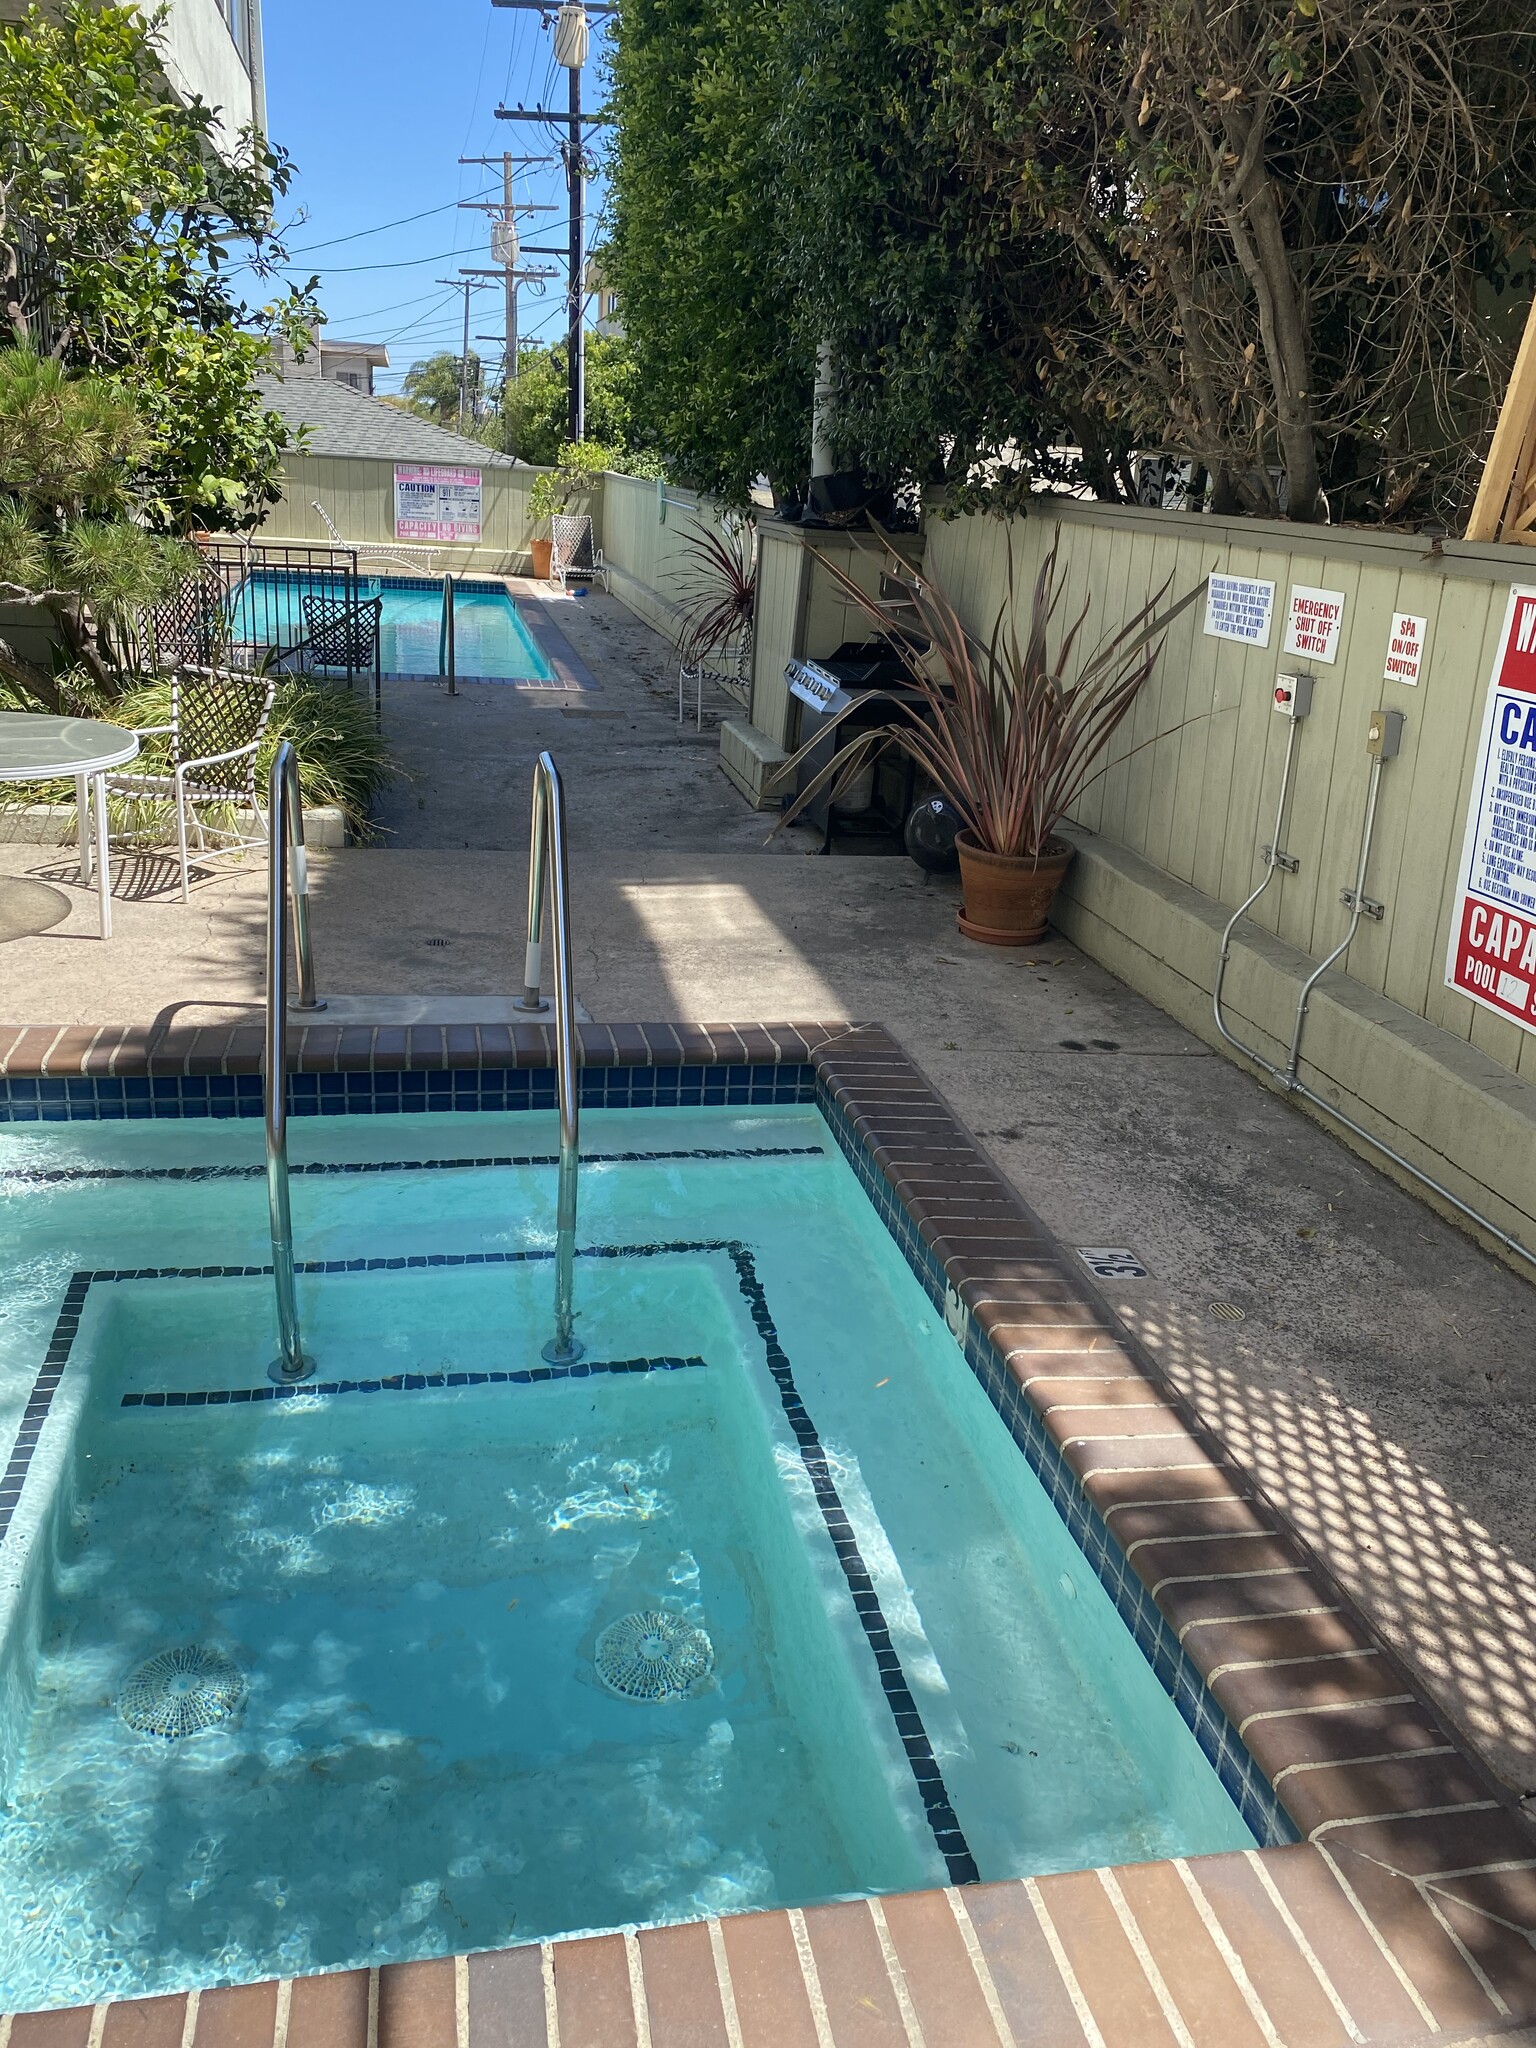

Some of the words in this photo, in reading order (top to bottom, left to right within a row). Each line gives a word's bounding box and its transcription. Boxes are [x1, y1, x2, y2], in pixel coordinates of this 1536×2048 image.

[399, 483, 435, 493] CAUTION
[442, 489, 451, 497] 911
[400, 521, 437, 531] CAPACITY
[1293, 598, 1340, 620] EMERGENCY
[1296, 616, 1315, 633] SHUT
[1318, 621, 1332, 636] OFF
[1400, 620, 1416, 637] SPA
[1296, 634, 1326, 653] SWITCH
[1392, 638, 1419, 657] ON/OFF
[1387, 657, 1417, 677] SWITCH
[1501, 749, 1518, 764] ELDERLY
[1500, 761, 1514, 775] HEALTH
[1499, 774, 1508, 786] WITH
[1512, 777, 1533, 794] PHYSICIAN
[1496, 788, 1523, 806] UNSUPERVISED
[1494, 803, 1502, 815] HOT
[1503, 805, 1515, 819] WATER
[1491, 827, 1519, 846] CONSEQUENCES
[1520, 836, 1528, 849] AND
[1516, 822, 1528, 836] DRUGS
[1489, 840, 1494, 851] DO
[1503, 845, 1511, 857] USE
[1486, 866, 1491, 877] OR
[1487, 854, 1496, 867] LONG
[1497, 858, 1516, 874] EXPOSURE
[1516, 865, 1525, 878] MAY
[1492, 881, 1511, 899] RESTROOM
[1512, 890, 1520, 902] AND
[1520, 893, 1535, 909] SHOWER
[1464, 954, 1496, 994] POOL
[1500, 977, 1518, 1000] 12
